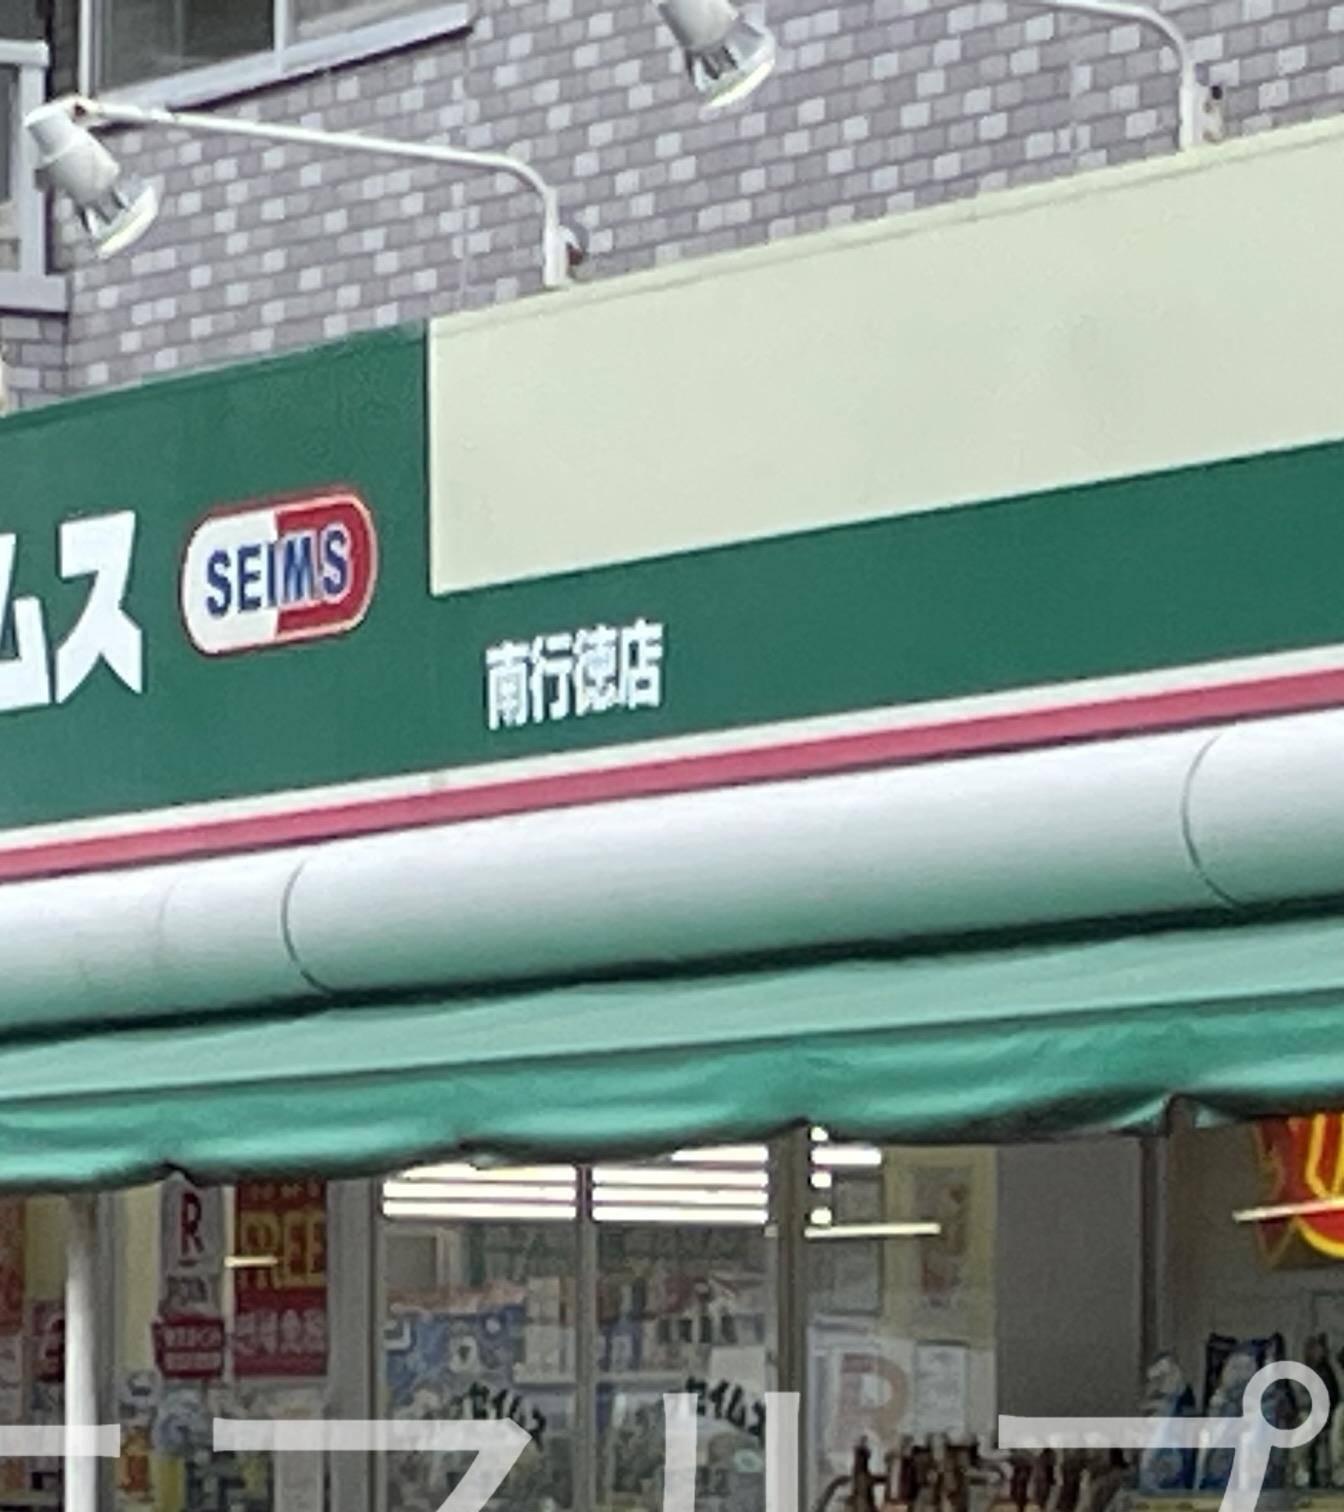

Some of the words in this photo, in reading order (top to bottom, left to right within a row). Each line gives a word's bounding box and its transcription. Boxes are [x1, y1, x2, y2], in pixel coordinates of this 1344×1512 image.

[205, 522, 350, 618] SEIMS
[485, 618, 665, 732] 南行徳店
